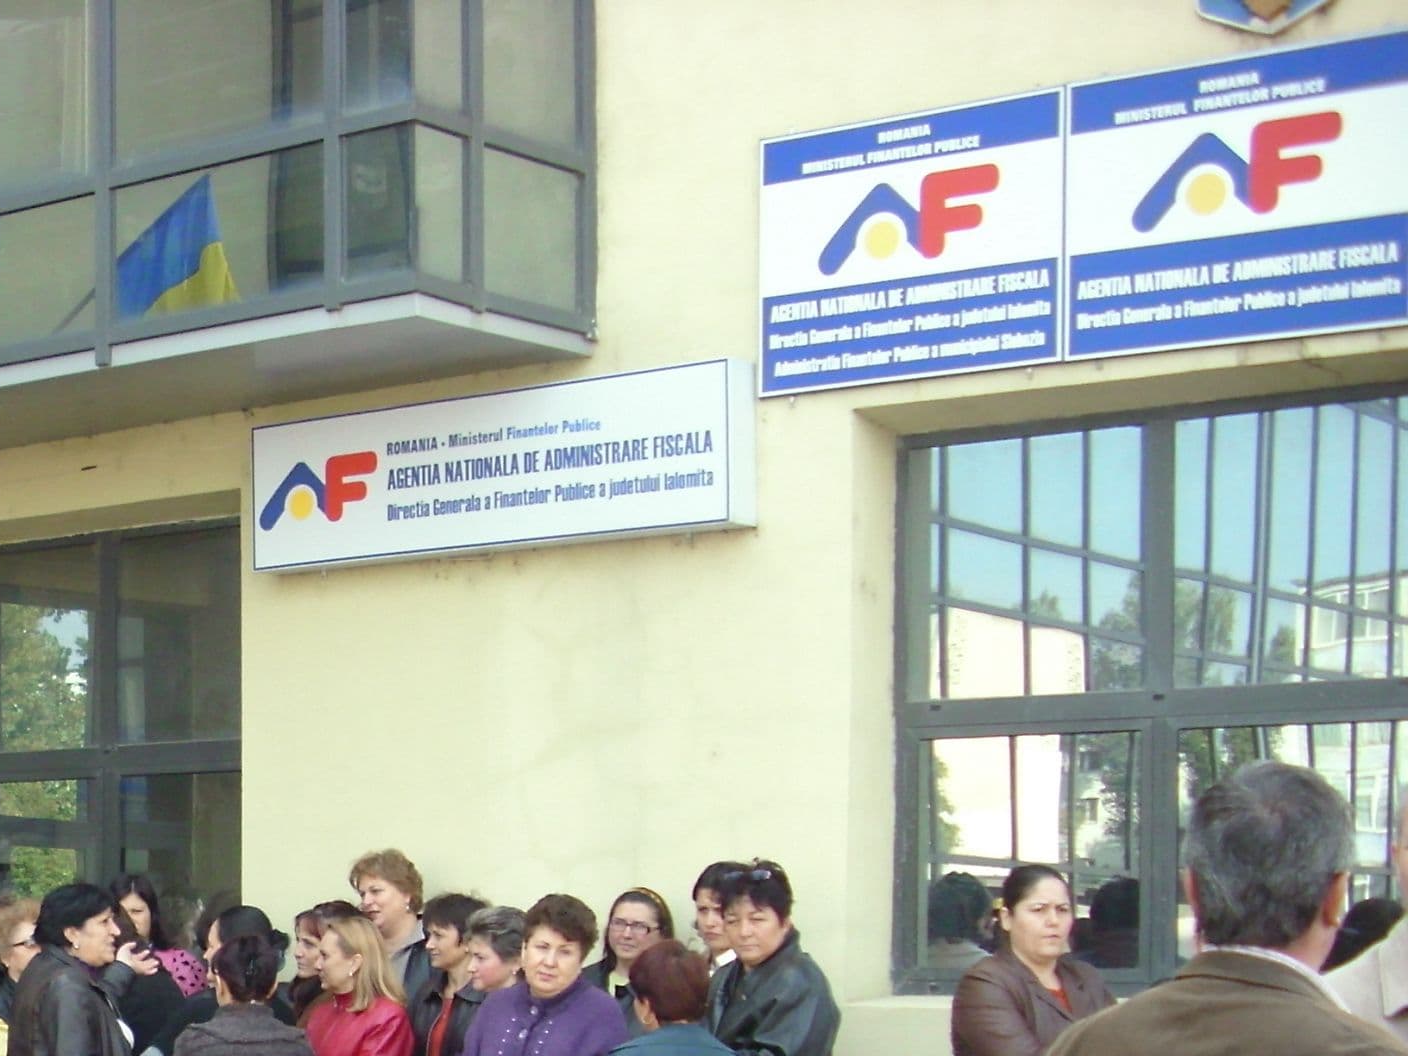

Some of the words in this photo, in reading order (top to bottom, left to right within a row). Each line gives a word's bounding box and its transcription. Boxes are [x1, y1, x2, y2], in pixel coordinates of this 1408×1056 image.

[1113, 102, 1187, 125] MINISTERUL
[1193, 87, 1269, 112] FINANTELOR
[1271, 77, 1326, 99] PUBLICE
[1198, 71, 1260, 94] ROMANIA
[802, 154, 865, 174] MINISTERUL
[867, 143, 932, 163] FINANTELOR
[934, 135, 980, 153] PUBLICE
[878, 124, 931, 144] ROMANIA
[1077, 275, 1132, 300] AGENTIA
[1134, 265, 1209, 293] NATIONALA
[1212, 263, 1230, 284] DE
[1232, 250, 1337, 281] ADMINISTRARE
[1339, 242, 1398, 268] FISCALA
[770, 300, 818, 323] AGENTIA
[820, 291, 887, 316] NATIONALA
[888, 288, 904, 307] DE
[905, 276, 996, 305] ADMINISTRARE
[998, 269, 1049, 293] FISCALA
[387, 437, 437, 455] ROMANIA
[449, 428, 503, 448] Ministerul
[507, 422, 558, 440] Finantelor
[562, 419, 601, 433] Publice
[388, 464, 440, 490] AGENTIA
[445, 453, 519, 483] NATIONALA
[524, 451, 539, 473] DE
[544, 438, 648, 471] ADMINISTRARE
[653, 430, 713, 458] FISCALA
[388, 501, 430, 521] Directia
[434, 495, 481, 515] Generala
[484, 497, 491, 510] a
[494, 488, 551, 509] Finantelor
[599, 482, 606, 497] a
[609, 474, 660, 499] judetului
[664, 469, 713, 490] Ialomita
